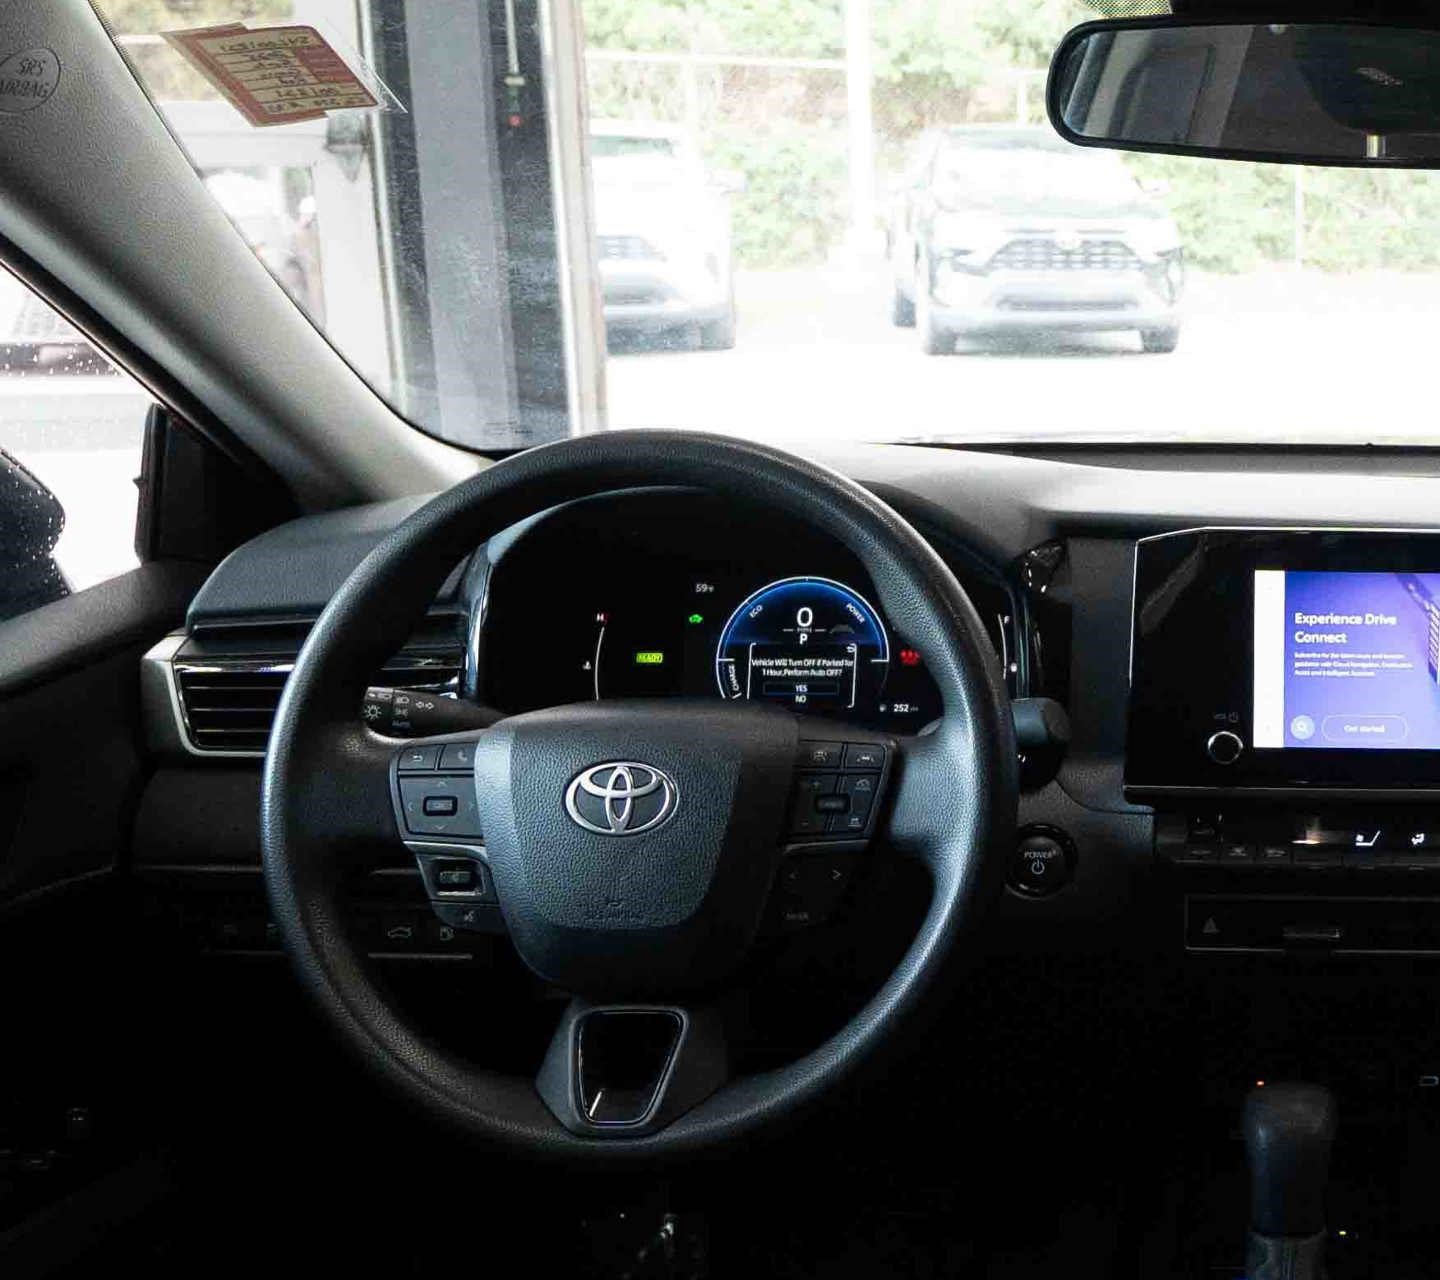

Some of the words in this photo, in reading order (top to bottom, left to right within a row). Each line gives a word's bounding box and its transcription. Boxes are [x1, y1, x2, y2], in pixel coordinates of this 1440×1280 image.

[19, 57, 47, 75] SRS
[749, 604, 763, 618] ECO
[796, 606, 813, 627] 0
[846, 602, 865, 624] POWER
[1295, 612, 1362, 626] Experience
[1364, 613, 1398, 626] Drive
[800, 633, 808, 645] P
[1294, 630, 1348, 644] Connect
[752, 658, 774, 667] Vehicle
[775, 658, 788, 667] Will
[788, 658, 803, 667] Turn
[804, 659, 816, 667] OFF
[822, 659, 844, 668] Parked
[729, 664, 740, 691] CHARGE
[810, 669, 826, 677] Auto
[795, 684, 808, 693] YES
[795, 695, 807, 704] NO
[893, 703, 909, 713] 252
